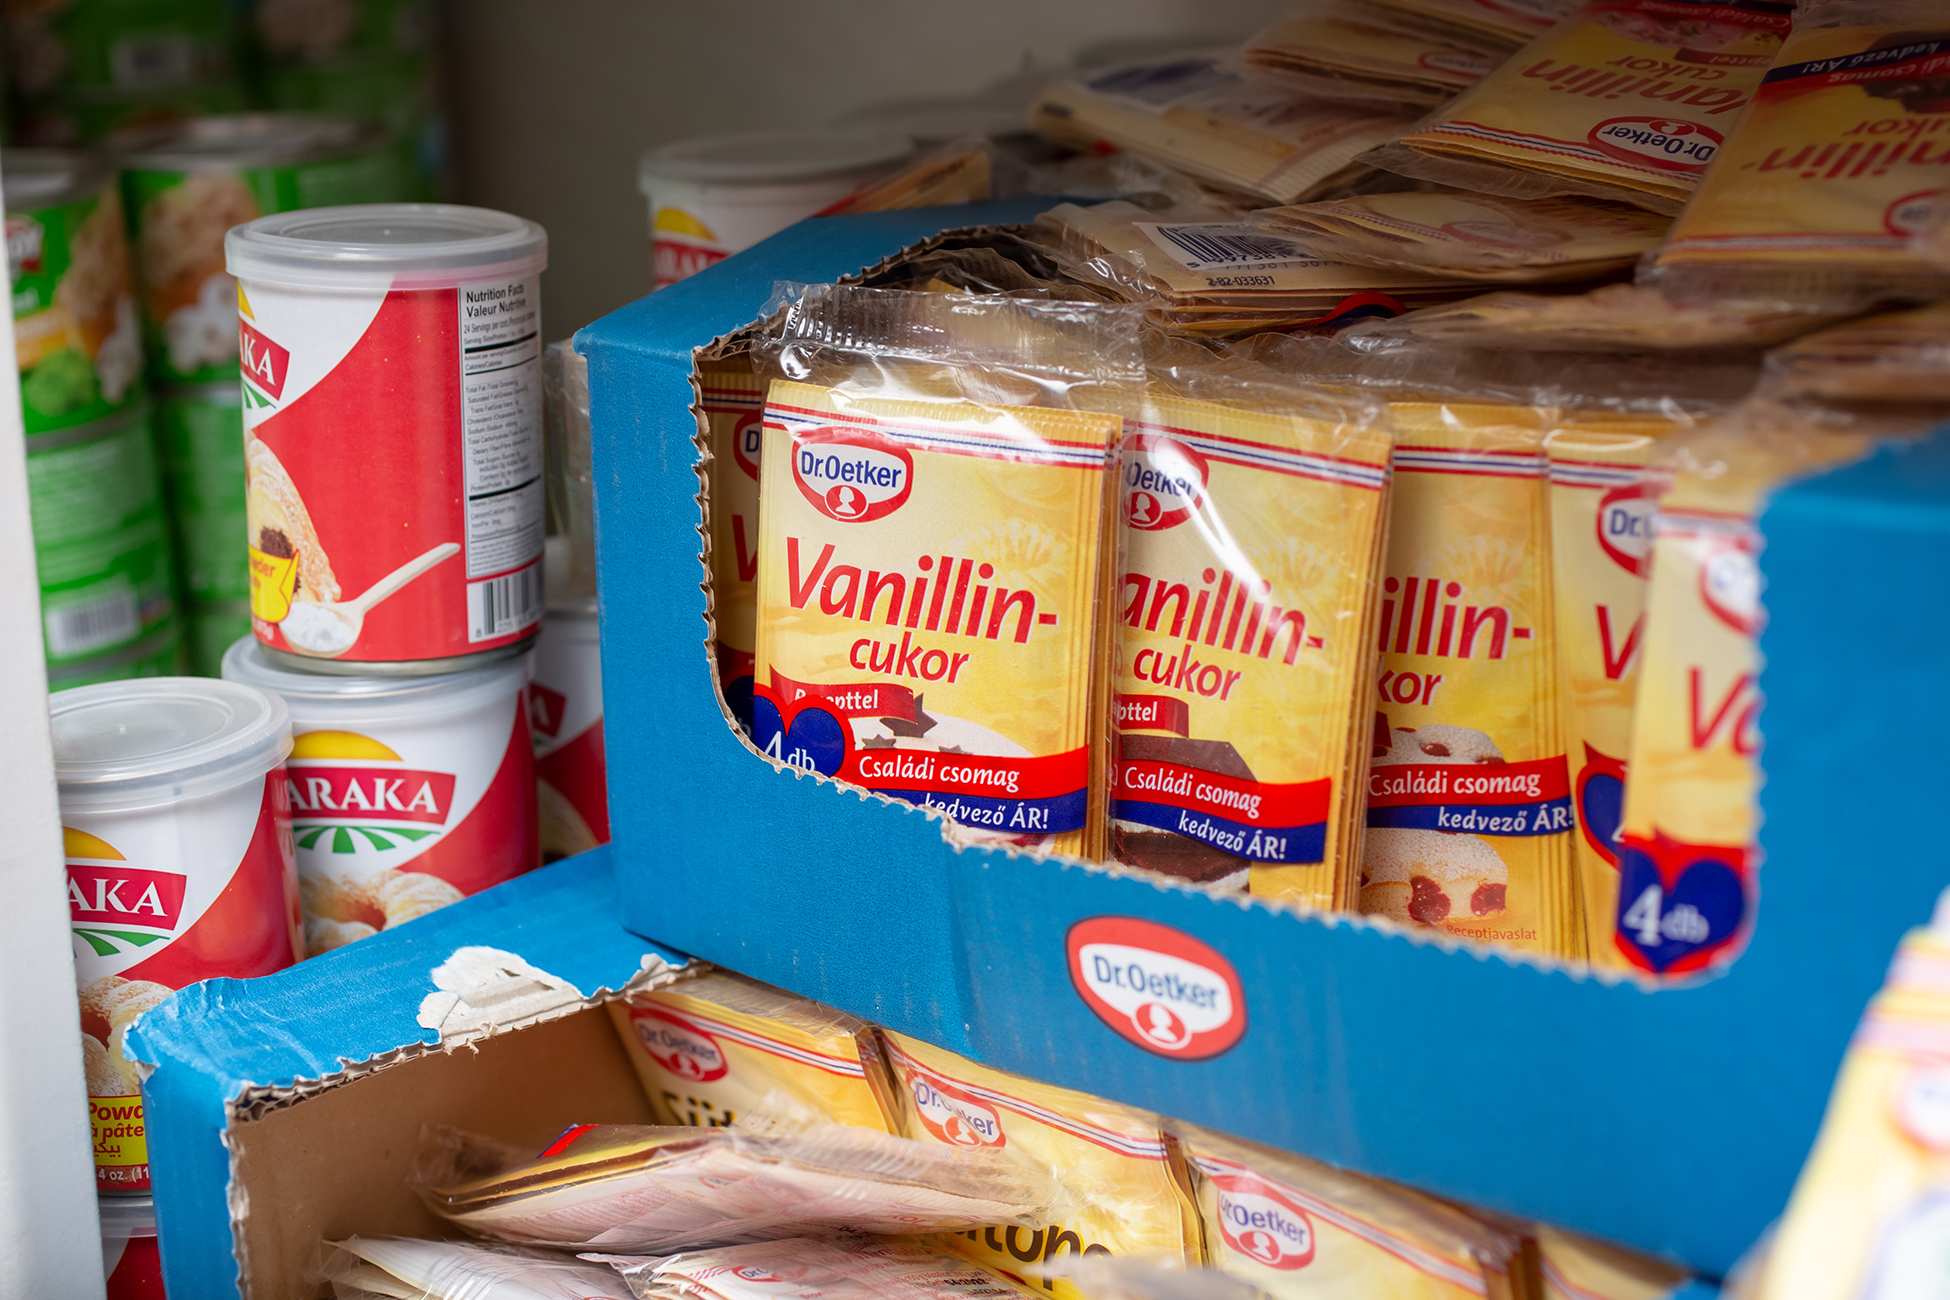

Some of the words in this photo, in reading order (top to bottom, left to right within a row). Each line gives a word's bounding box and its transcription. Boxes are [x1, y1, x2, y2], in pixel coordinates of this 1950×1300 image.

[1849, 41, 1941, 67] kedvező
[1606, 54, 1727, 82] cukor
[1827, 63, 1917, 83] csomag
[466, 287, 506, 303] Nutrition
[508, 284, 524, 297] Facts
[466, 304, 497, 318] Valeur
[787, 536, 1060, 645] Vanillin-
[849, 631, 971, 684] cukor
[1133, 643, 1243, 702] cukor
[795, 688, 878, 710] Rpttel
[859, 754, 935, 780] Családi
[939, 764, 1020, 793] csomag
[1368, 770, 1448, 797] Családi
[1453, 773, 1541, 797] csomag
[1125, 766, 1193, 797] Családi
[1196, 782, 1262, 820] csomag
[1009, 802, 1049, 830] ÁR!
[1438, 806, 1527, 832] kedvező
[1532, 803, 1575, 831] ÁR!
[1178, 810, 1246, 852] kedvező
[1246, 829, 1287, 860] ÁR!
[1446, 924, 1537, 944] Receptjavaslat
[103, 1122, 144, 1143] pâte
[109, 1171, 128, 1181] oz.
